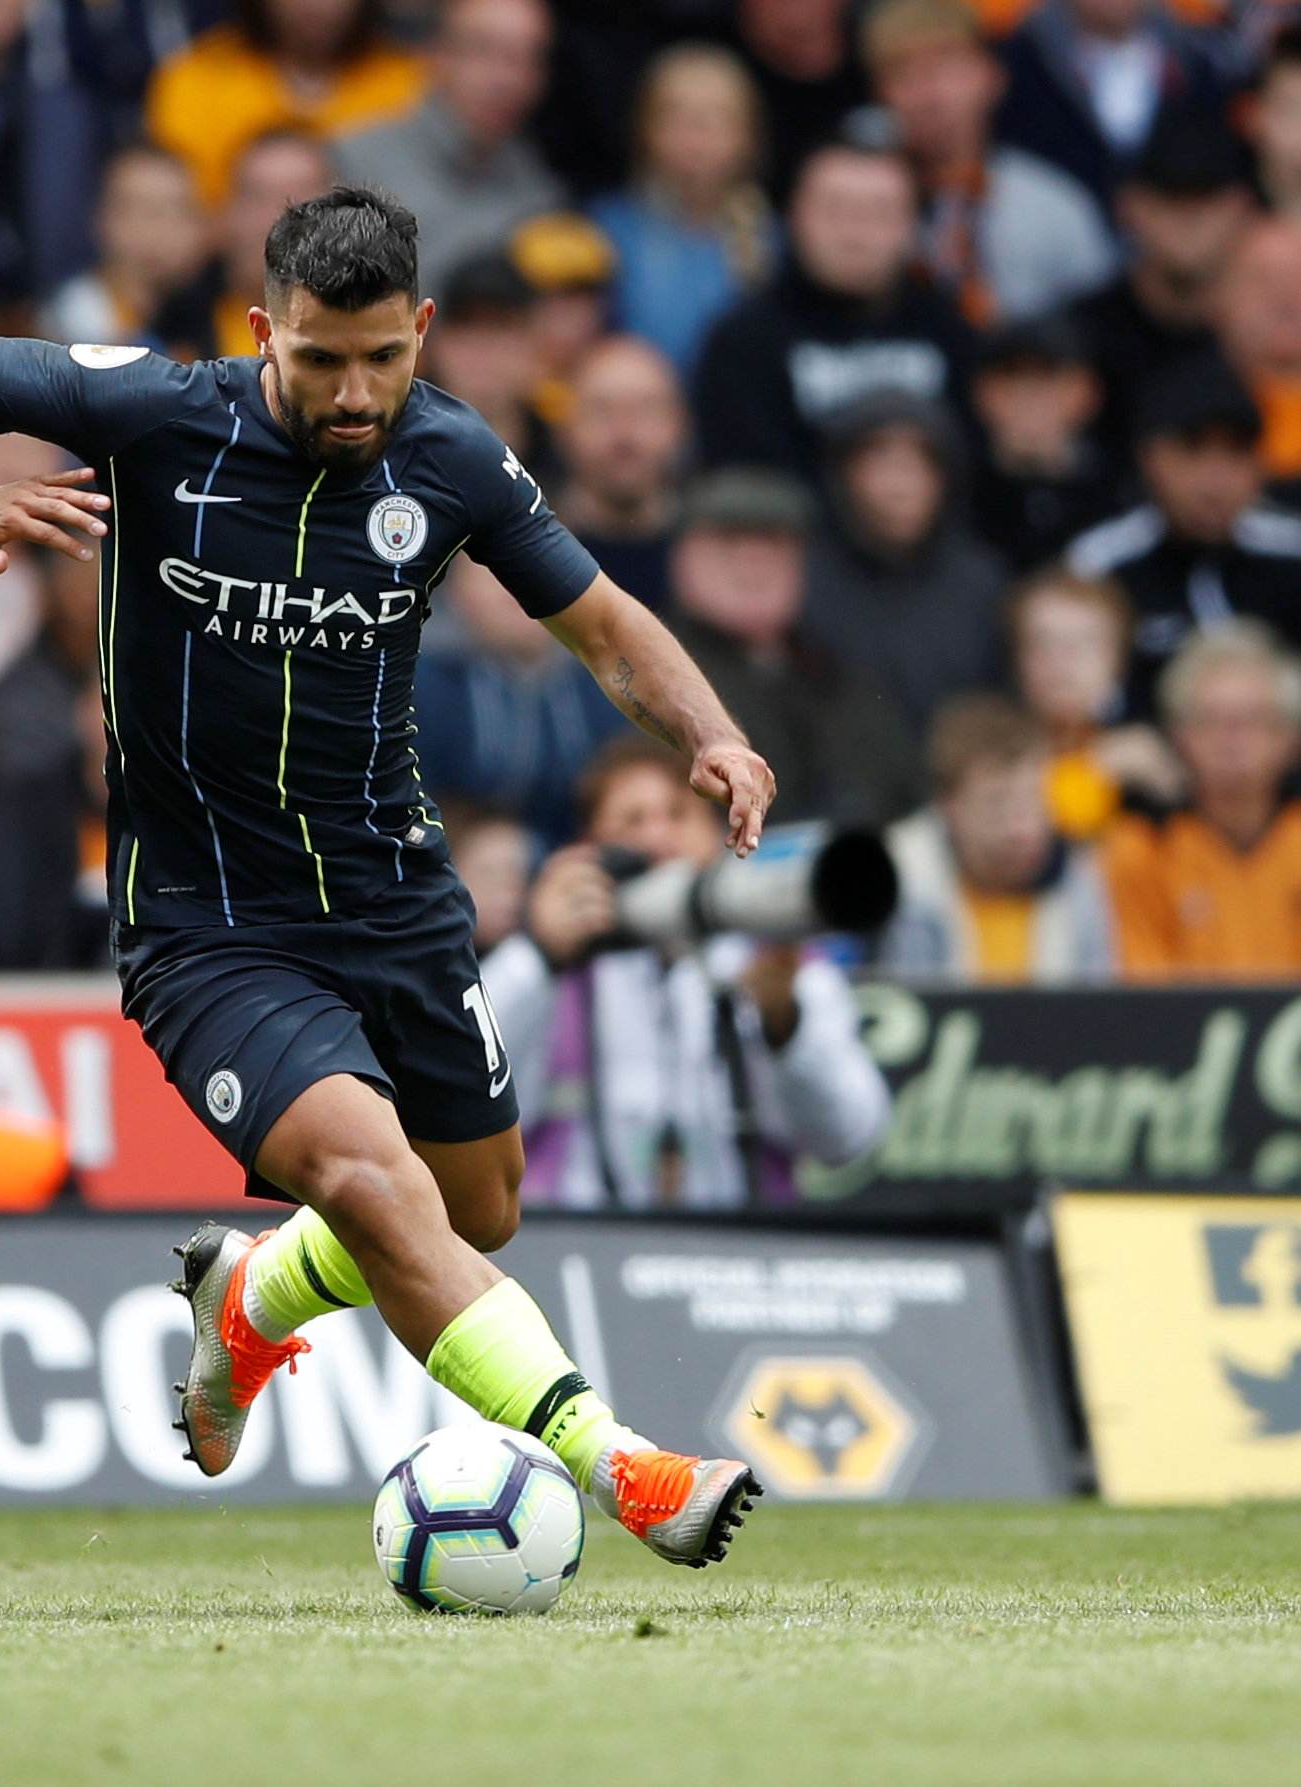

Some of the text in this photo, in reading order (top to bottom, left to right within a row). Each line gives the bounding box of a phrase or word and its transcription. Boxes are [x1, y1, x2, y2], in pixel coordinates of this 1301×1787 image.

[374, 498, 423, 521] MANCHESTER
[386, 551, 405, 560] CITY
[158, 557, 416, 626] ETIHAD
[203, 614, 376, 651] AIRWAYS
[462, 982, 506, 1074] 1
